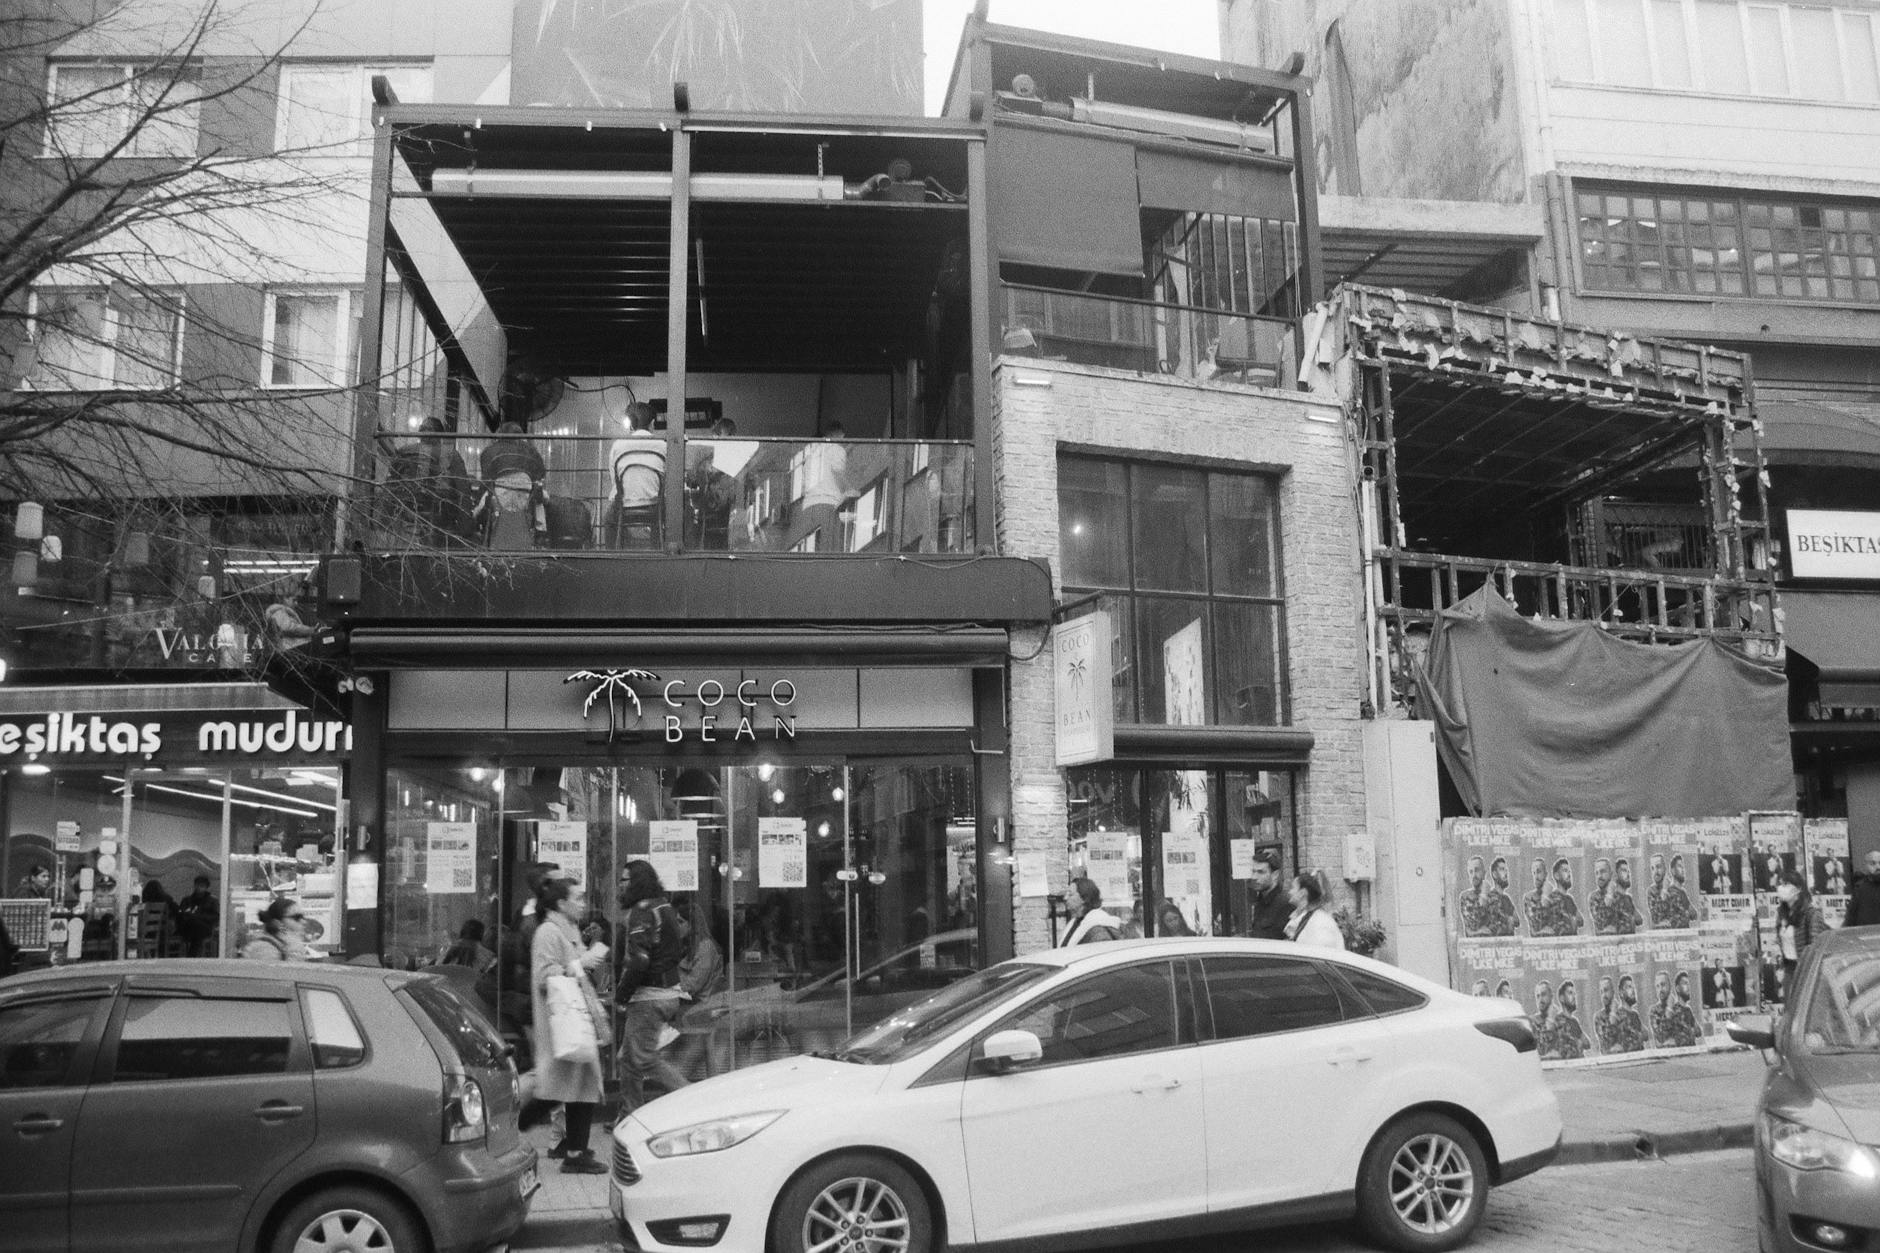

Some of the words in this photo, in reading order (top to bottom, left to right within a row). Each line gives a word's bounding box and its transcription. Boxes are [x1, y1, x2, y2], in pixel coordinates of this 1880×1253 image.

[154, 627, 264, 659] VALOIA
[1061, 633, 1090, 653] COCO
[188, 653, 252, 663] CAE
[663, 679, 796, 707] COCO
[664, 715, 795, 742] BEAN
[1063, 708, 1091, 727] BEAN
[199, 710, 353, 752] mudur
[1491, 824, 1520, 835] VEGAS
